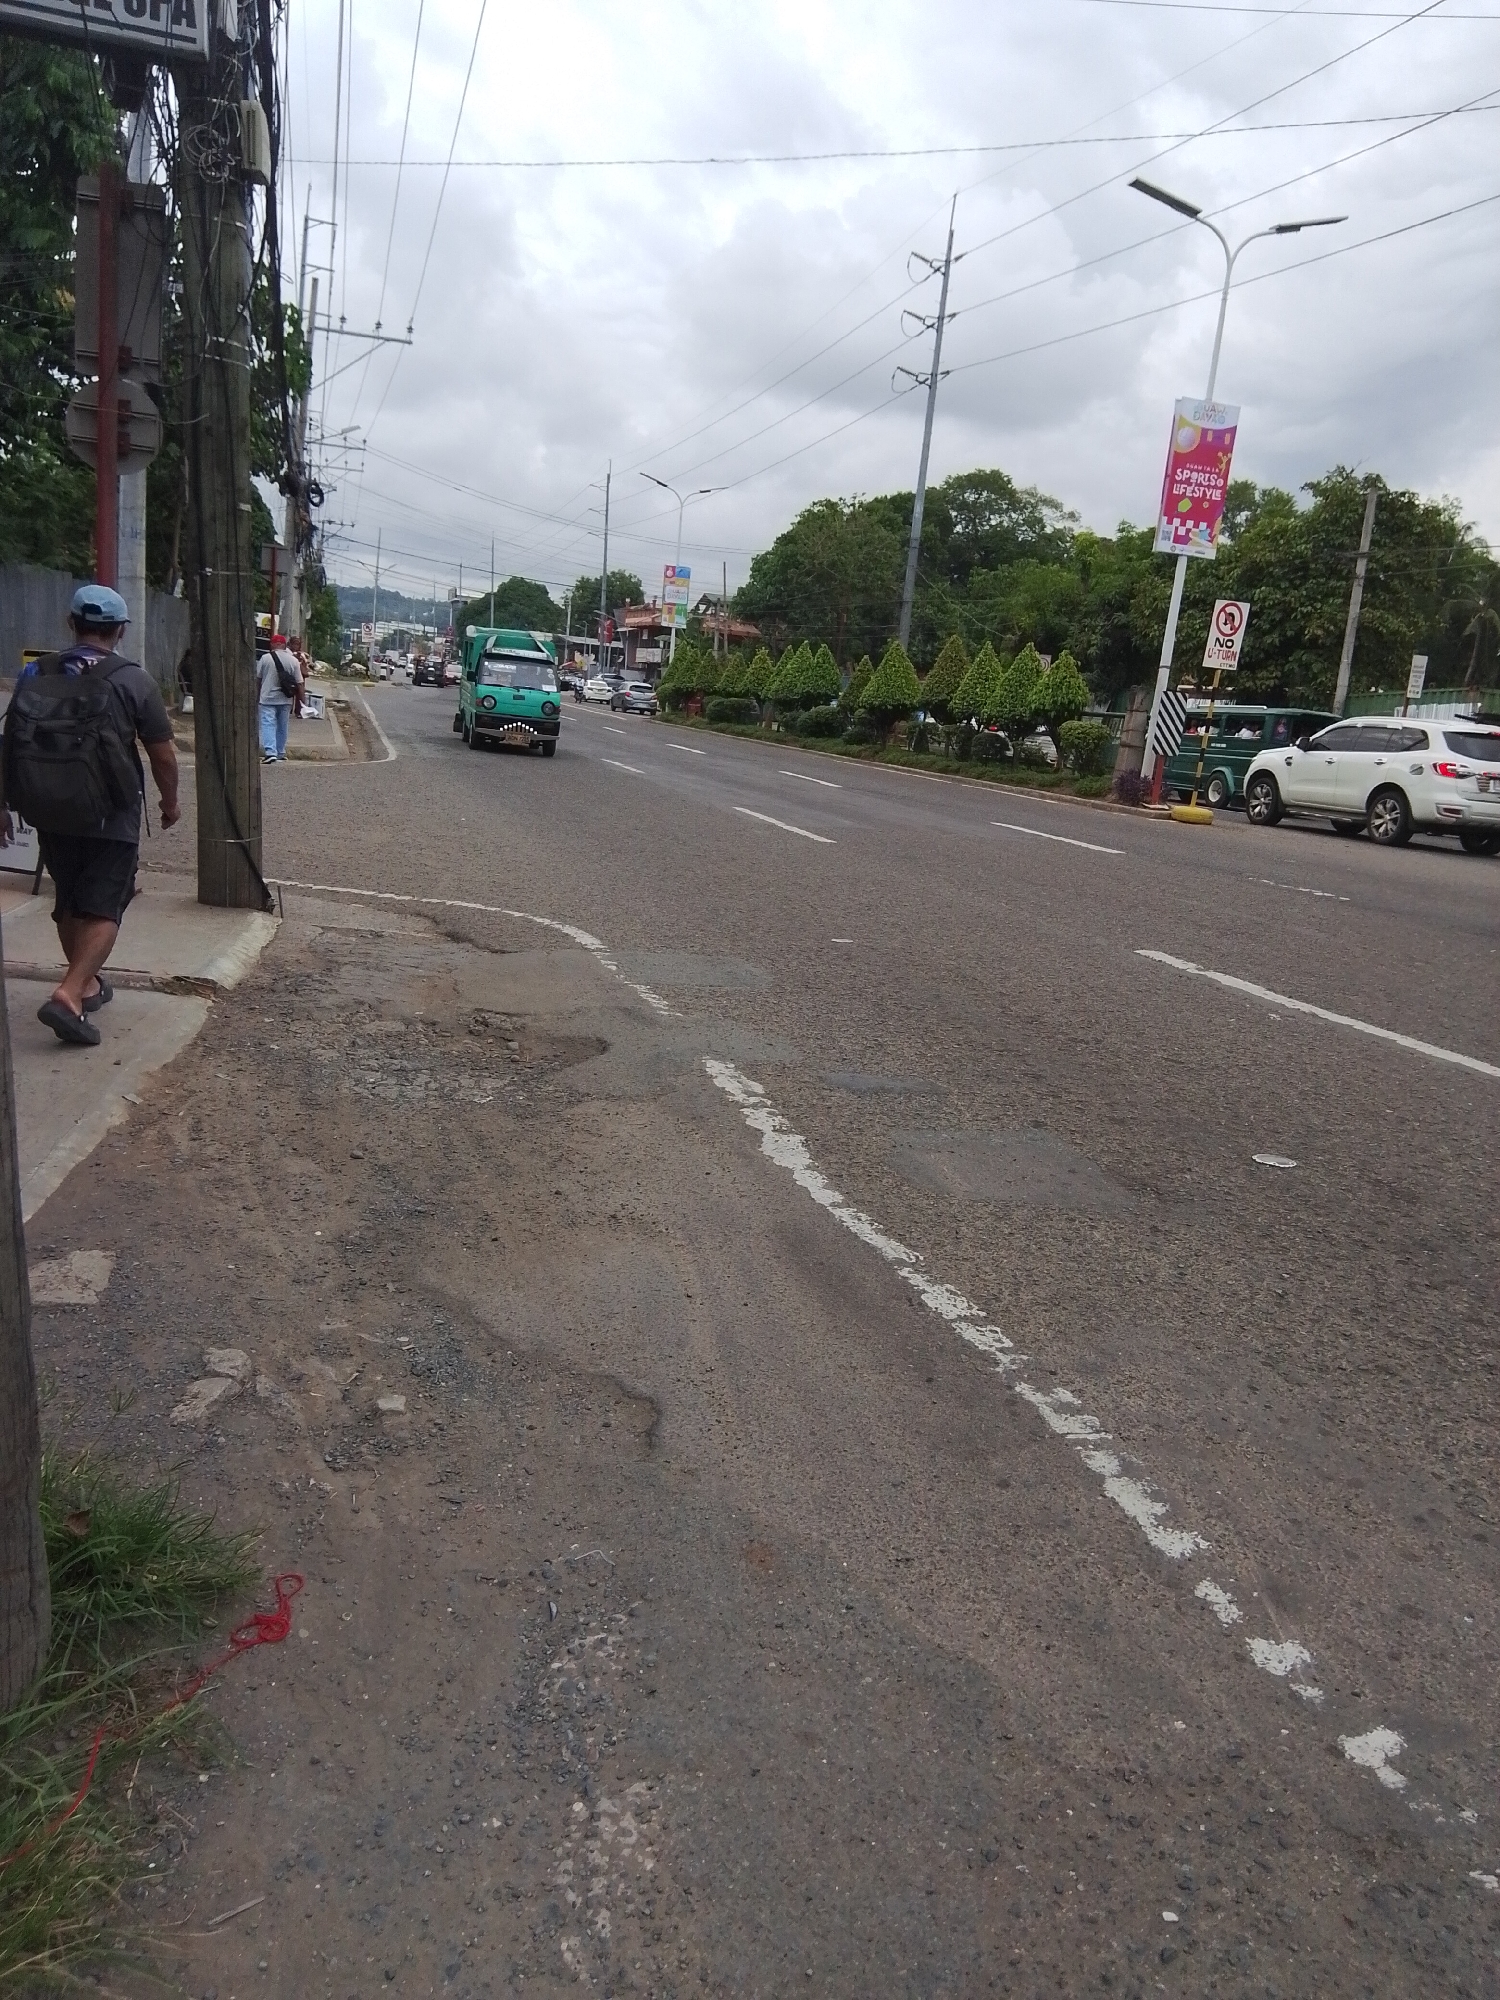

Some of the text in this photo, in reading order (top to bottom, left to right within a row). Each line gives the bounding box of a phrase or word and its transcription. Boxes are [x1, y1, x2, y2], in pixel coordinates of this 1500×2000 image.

[1193, 411, 1226, 424] DAVAO
[1174, 468, 1218, 486] SPORTS
[1172, 483, 1222, 500] LIFESTYLE
[1213, 637, 1235, 649] NO
[1207, 648, 1237, 661] U-TURN
